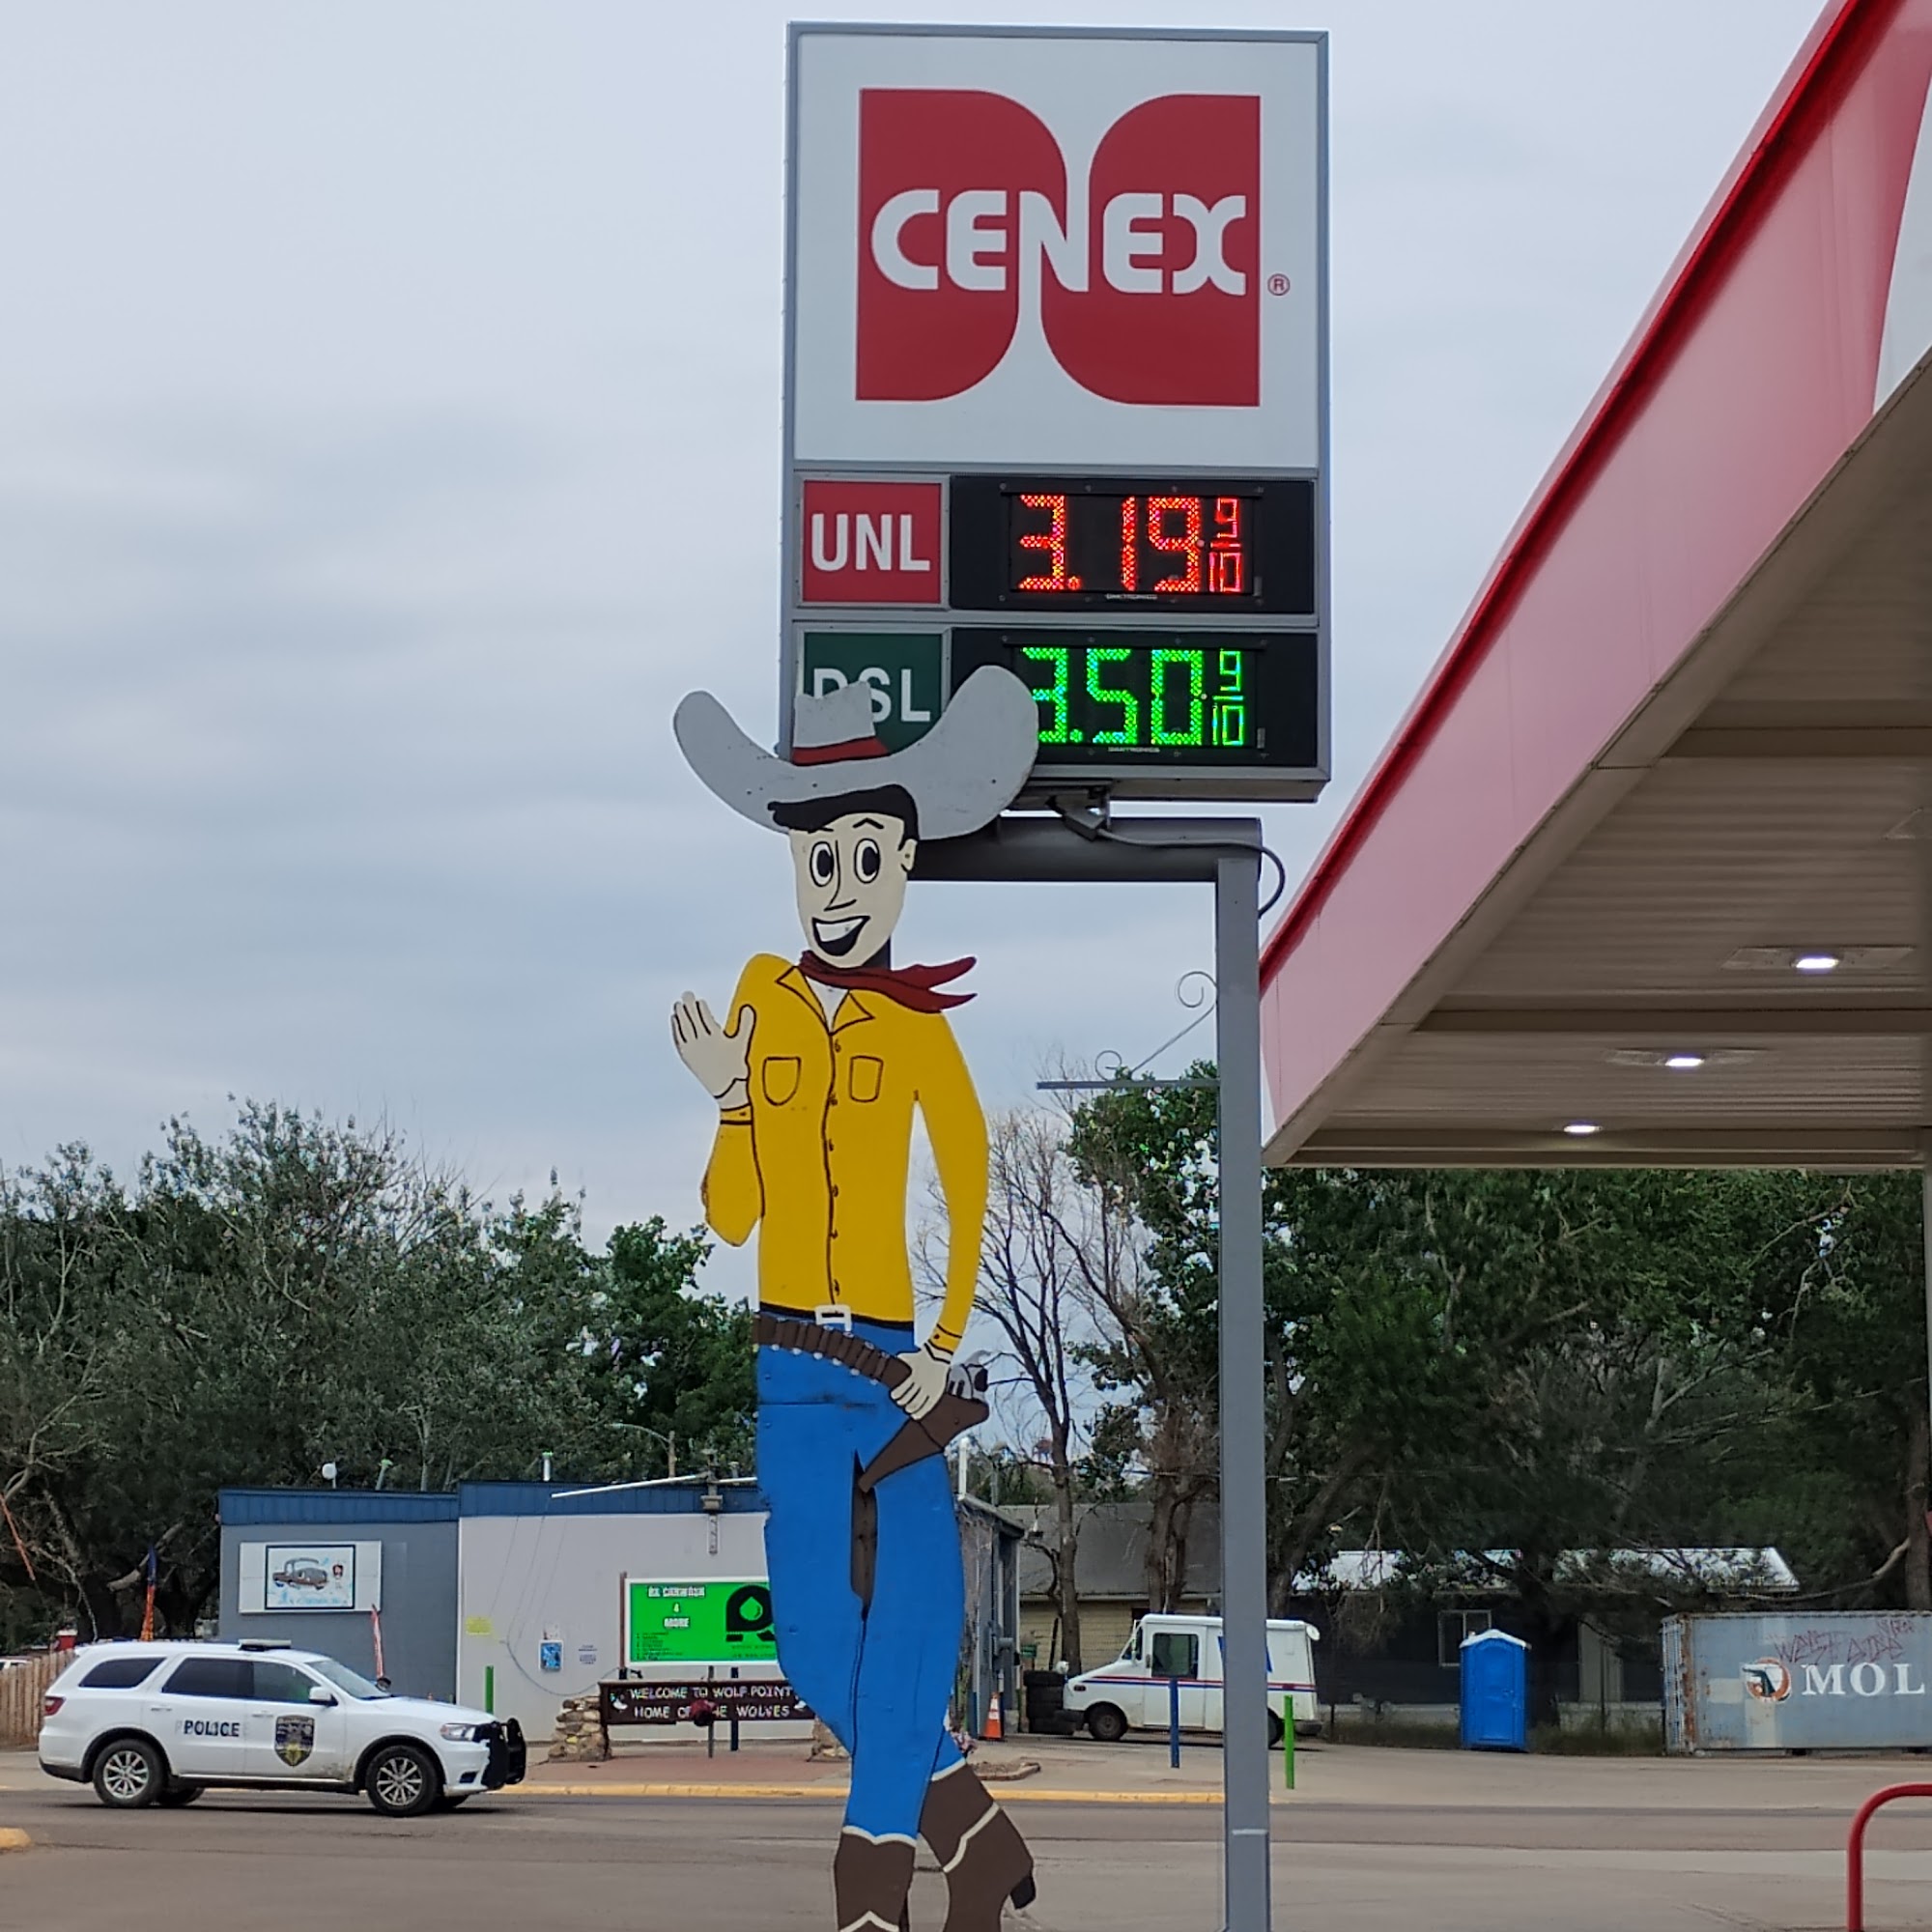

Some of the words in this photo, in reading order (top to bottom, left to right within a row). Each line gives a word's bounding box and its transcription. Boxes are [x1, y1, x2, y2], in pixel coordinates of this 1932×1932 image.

[871, 188, 1247, 296] CENEX
[810, 513, 931, 572] UNL
[1019, 495, 1200, 592] 3.19
[1022, 647, 1203, 745] 3.50
[629, 1687, 688, 1699] WELCOME
[693, 1688, 707, 1698] TO
[713, 1687, 748, 1698] WOLF
[751, 1687, 792, 1699] POINT
[1801, 1662, 1925, 1696] MOL
[184, 1719, 240, 1737] POLICE
[635, 1706, 670, 1719] HOME
[736, 1704, 790, 1718] WOLVES
